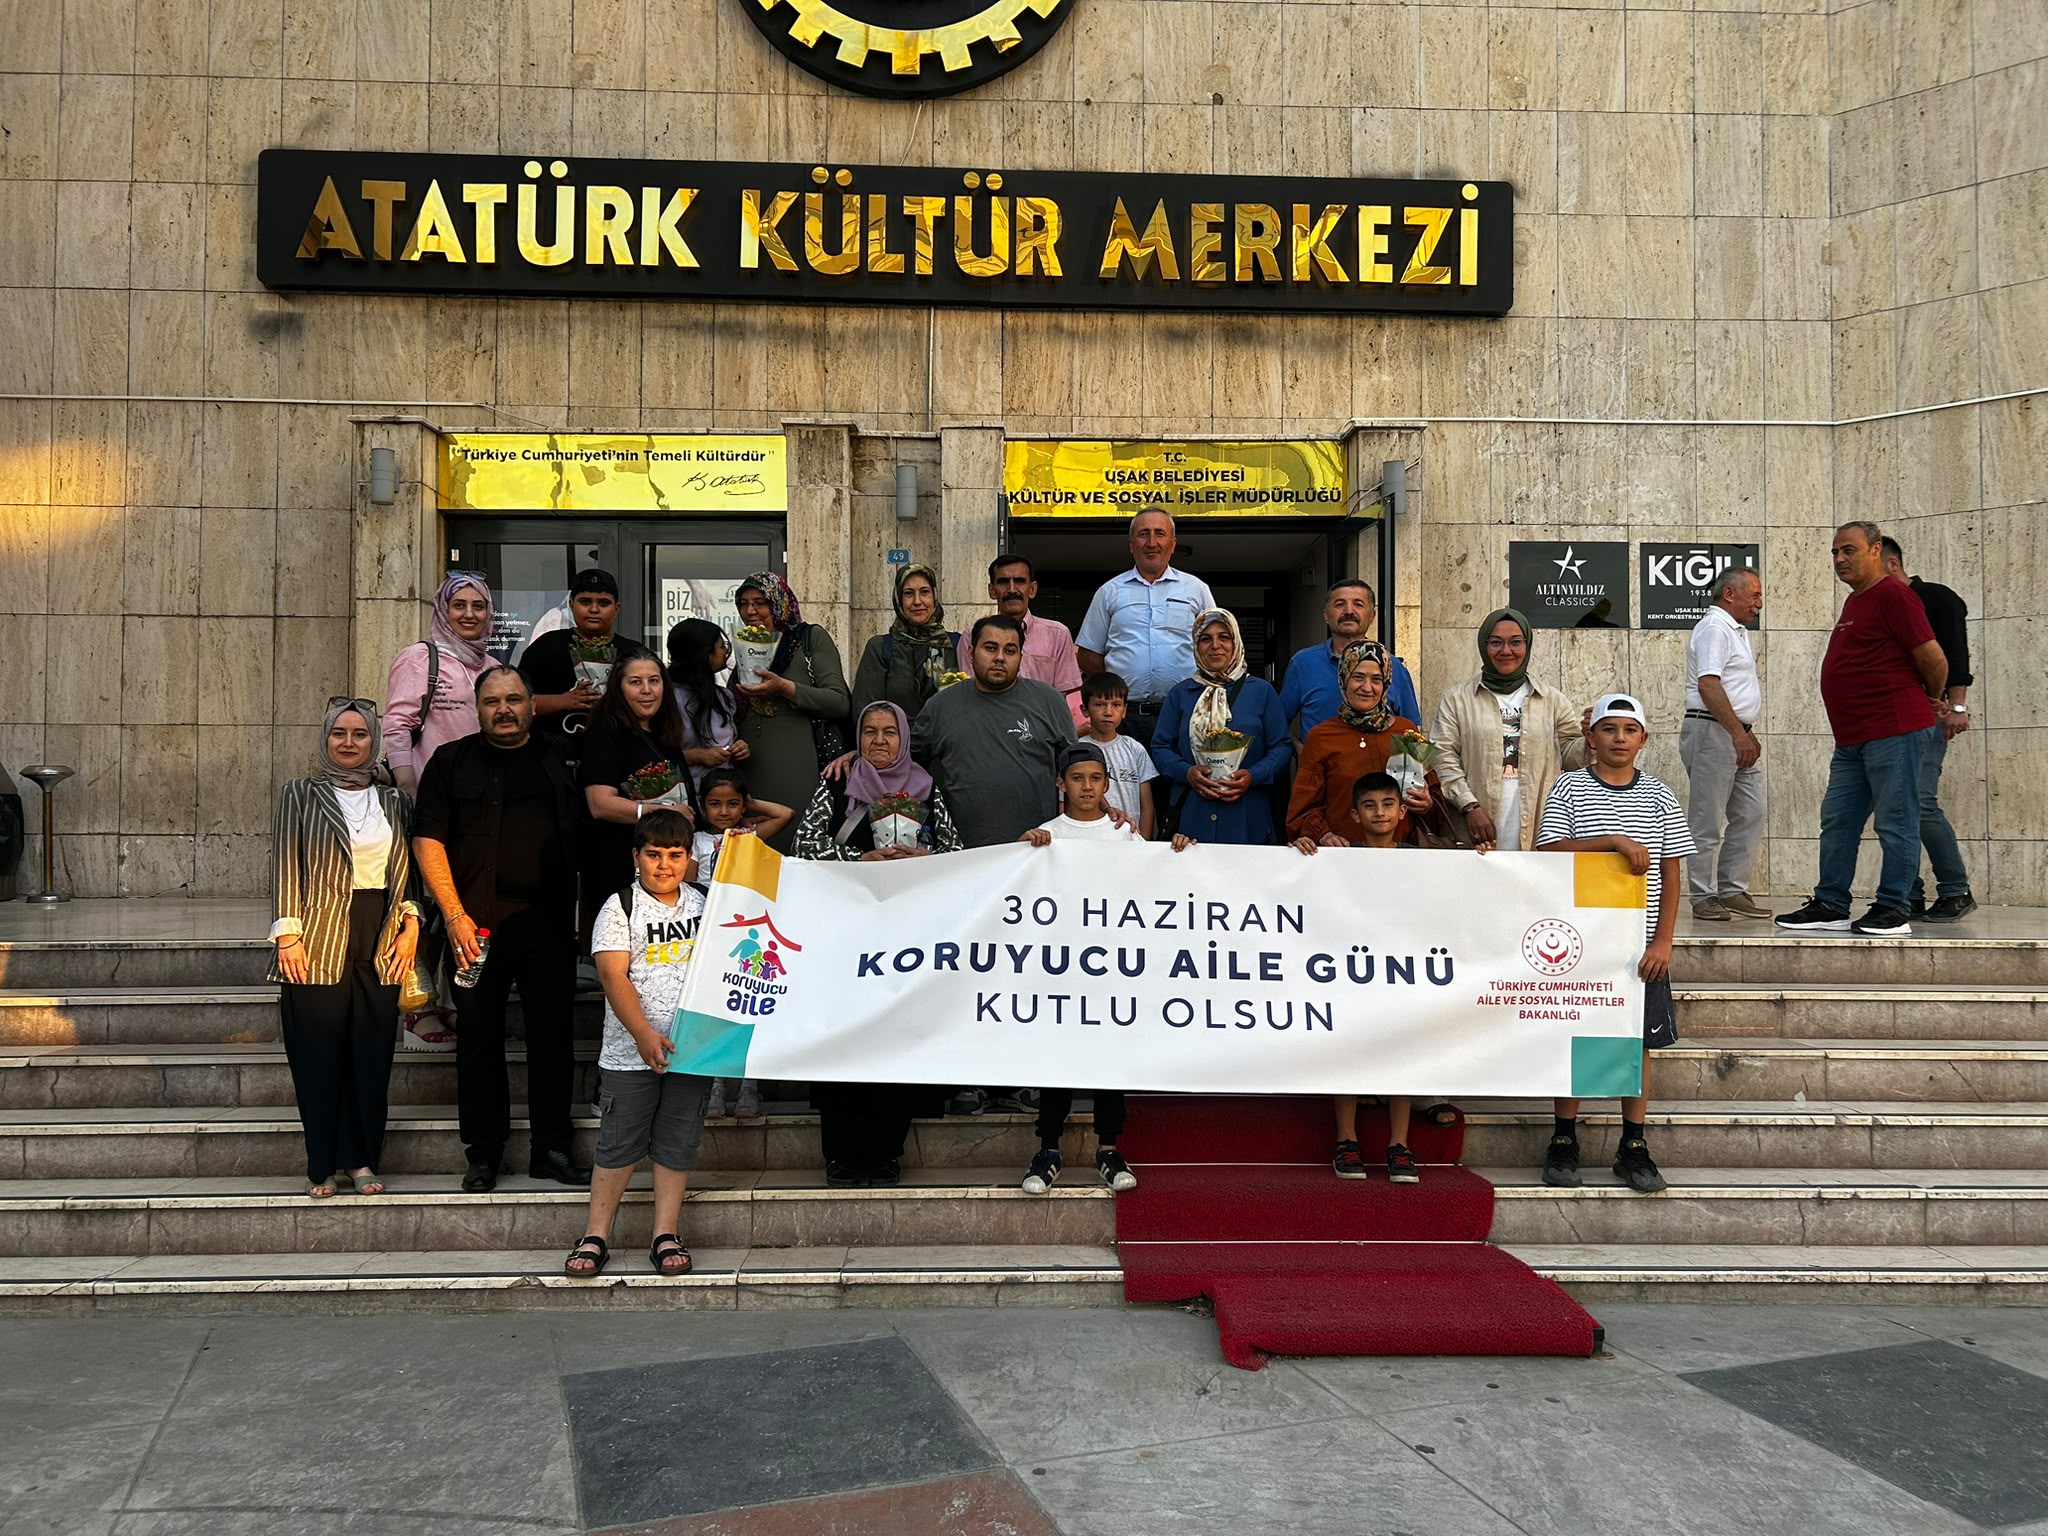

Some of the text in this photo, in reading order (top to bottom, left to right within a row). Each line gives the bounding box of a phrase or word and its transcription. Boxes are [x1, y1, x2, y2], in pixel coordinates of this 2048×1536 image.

[295, 160, 1480, 287] ATATÜRK KÜLTÜR MERKEZİ
[644, 448, 691, 462] Temeli
[1163, 452, 1188, 463] T.C.
[1104, 467, 1245, 485] UŞAK BELEDİYESİ
[1009, 486, 1342, 506] KÜLTÜR VE SOSYAL İŞLER MÜDÜRLÜĞÜ
[893, 552, 904, 560] 49
[1535, 584, 1605, 595] ALTINYILDIZ
[666, 587, 691, 611] BİZ
[1545, 597, 1595, 606] CLASSICS
[1002, 893, 1304, 934] 30 HAZİRAN
[857, 940, 1454, 987] KORUYUCU AİLE GÜNÜ
[1488, 979, 1613, 992] TÜRKİYE CUMHURİYETİ
[726, 989, 777, 1016] aile
[1476, 994, 1625, 1007] AİLE VE SOSYAL HİZMETLER
[976, 992, 1334, 1032] KUTLU OLSUN
[1519, 1009, 1581, 1021] BAKANLIĞI
